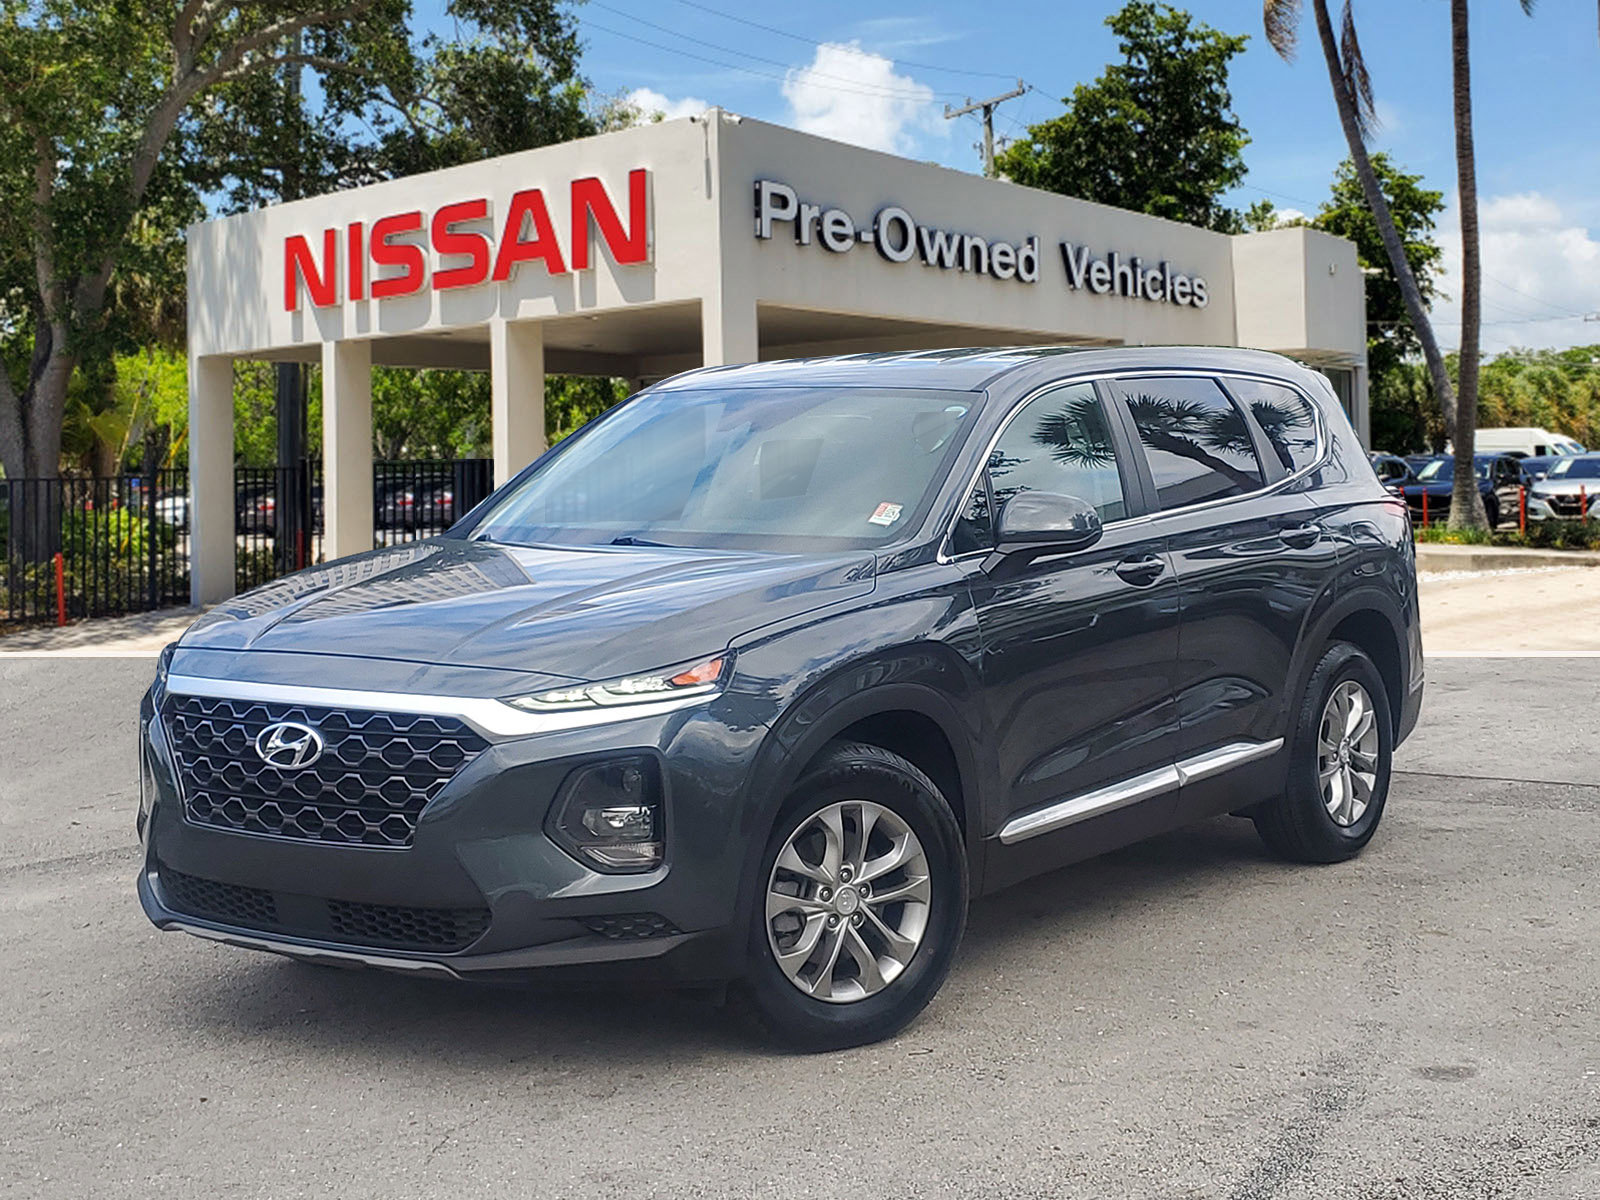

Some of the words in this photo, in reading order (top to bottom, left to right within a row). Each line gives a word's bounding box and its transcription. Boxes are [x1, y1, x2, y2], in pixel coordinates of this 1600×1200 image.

[285, 168, 649, 311] NISSAN
[754, 179, 1040, 283] Pre-Owned
[1060, 241, 1208, 308] Vehicles
